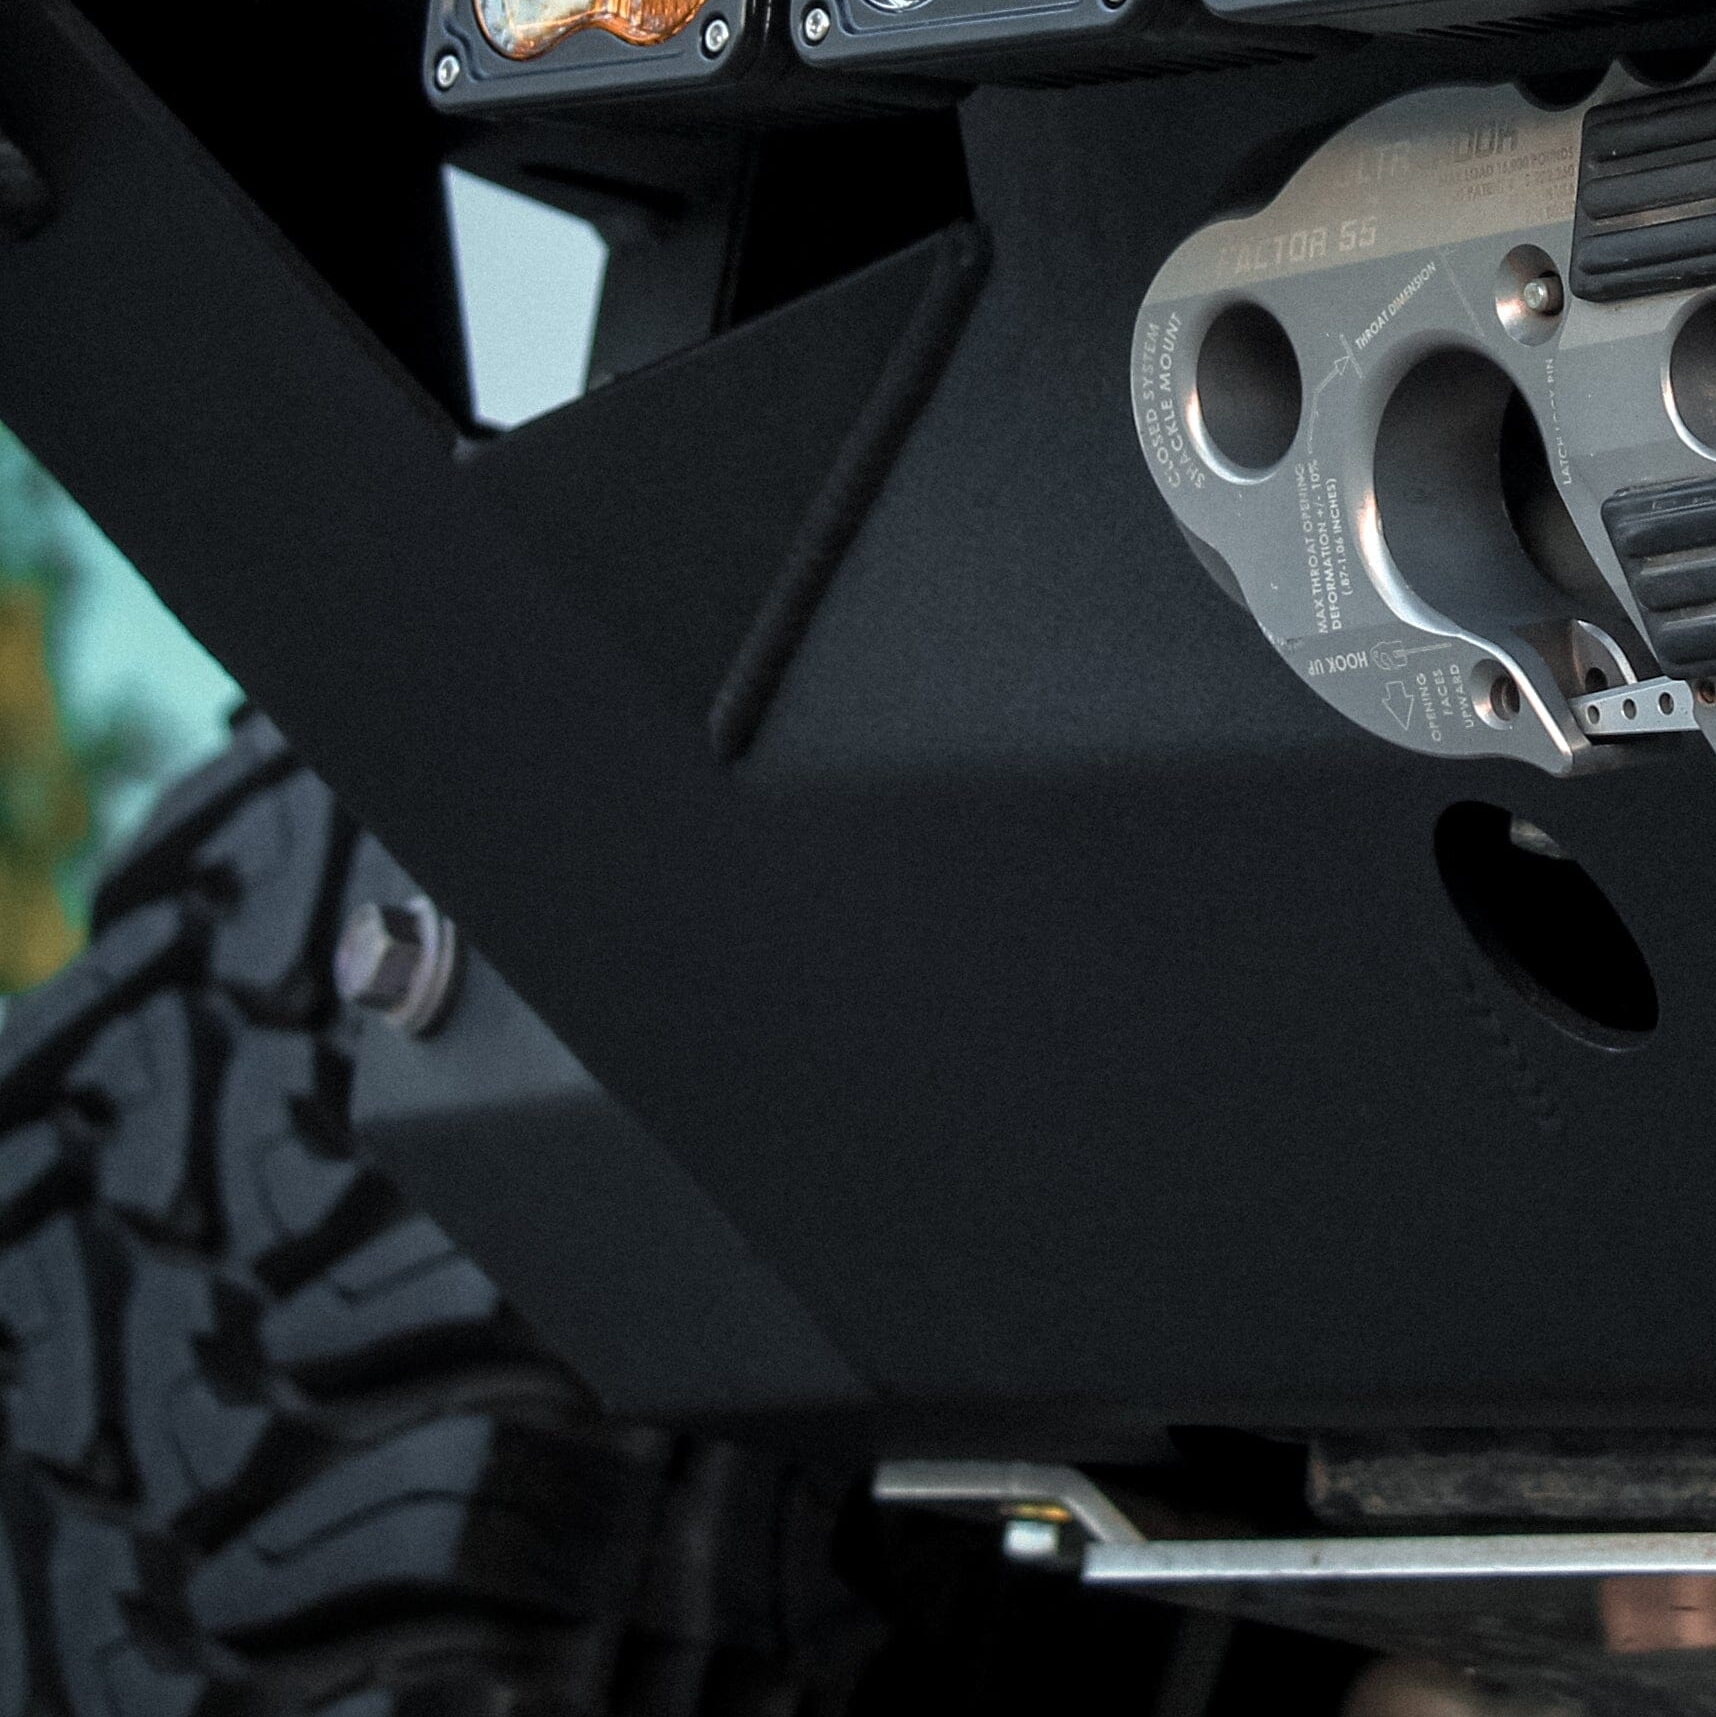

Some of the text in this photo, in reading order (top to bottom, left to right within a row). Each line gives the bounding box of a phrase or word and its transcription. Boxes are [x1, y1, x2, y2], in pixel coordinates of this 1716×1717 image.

[1354, 261, 1437, 350] THROAT DIMENSION
[1142, 323, 1181, 488] CLOSED SYSTEM
[1159, 311, 1205, 488] SHACKLE MOUNT
[1295, 463, 1328, 634] MAX THROAT OPENING
[1326, 478, 1343, 534] INCHES)
[1317, 522, 1342, 630] DEFORMATION
[1308, 650, 1368, 676] HOOK UP
[1416, 672, 1442, 742] OPENING
[1450, 664, 1474, 729] UPWARD
